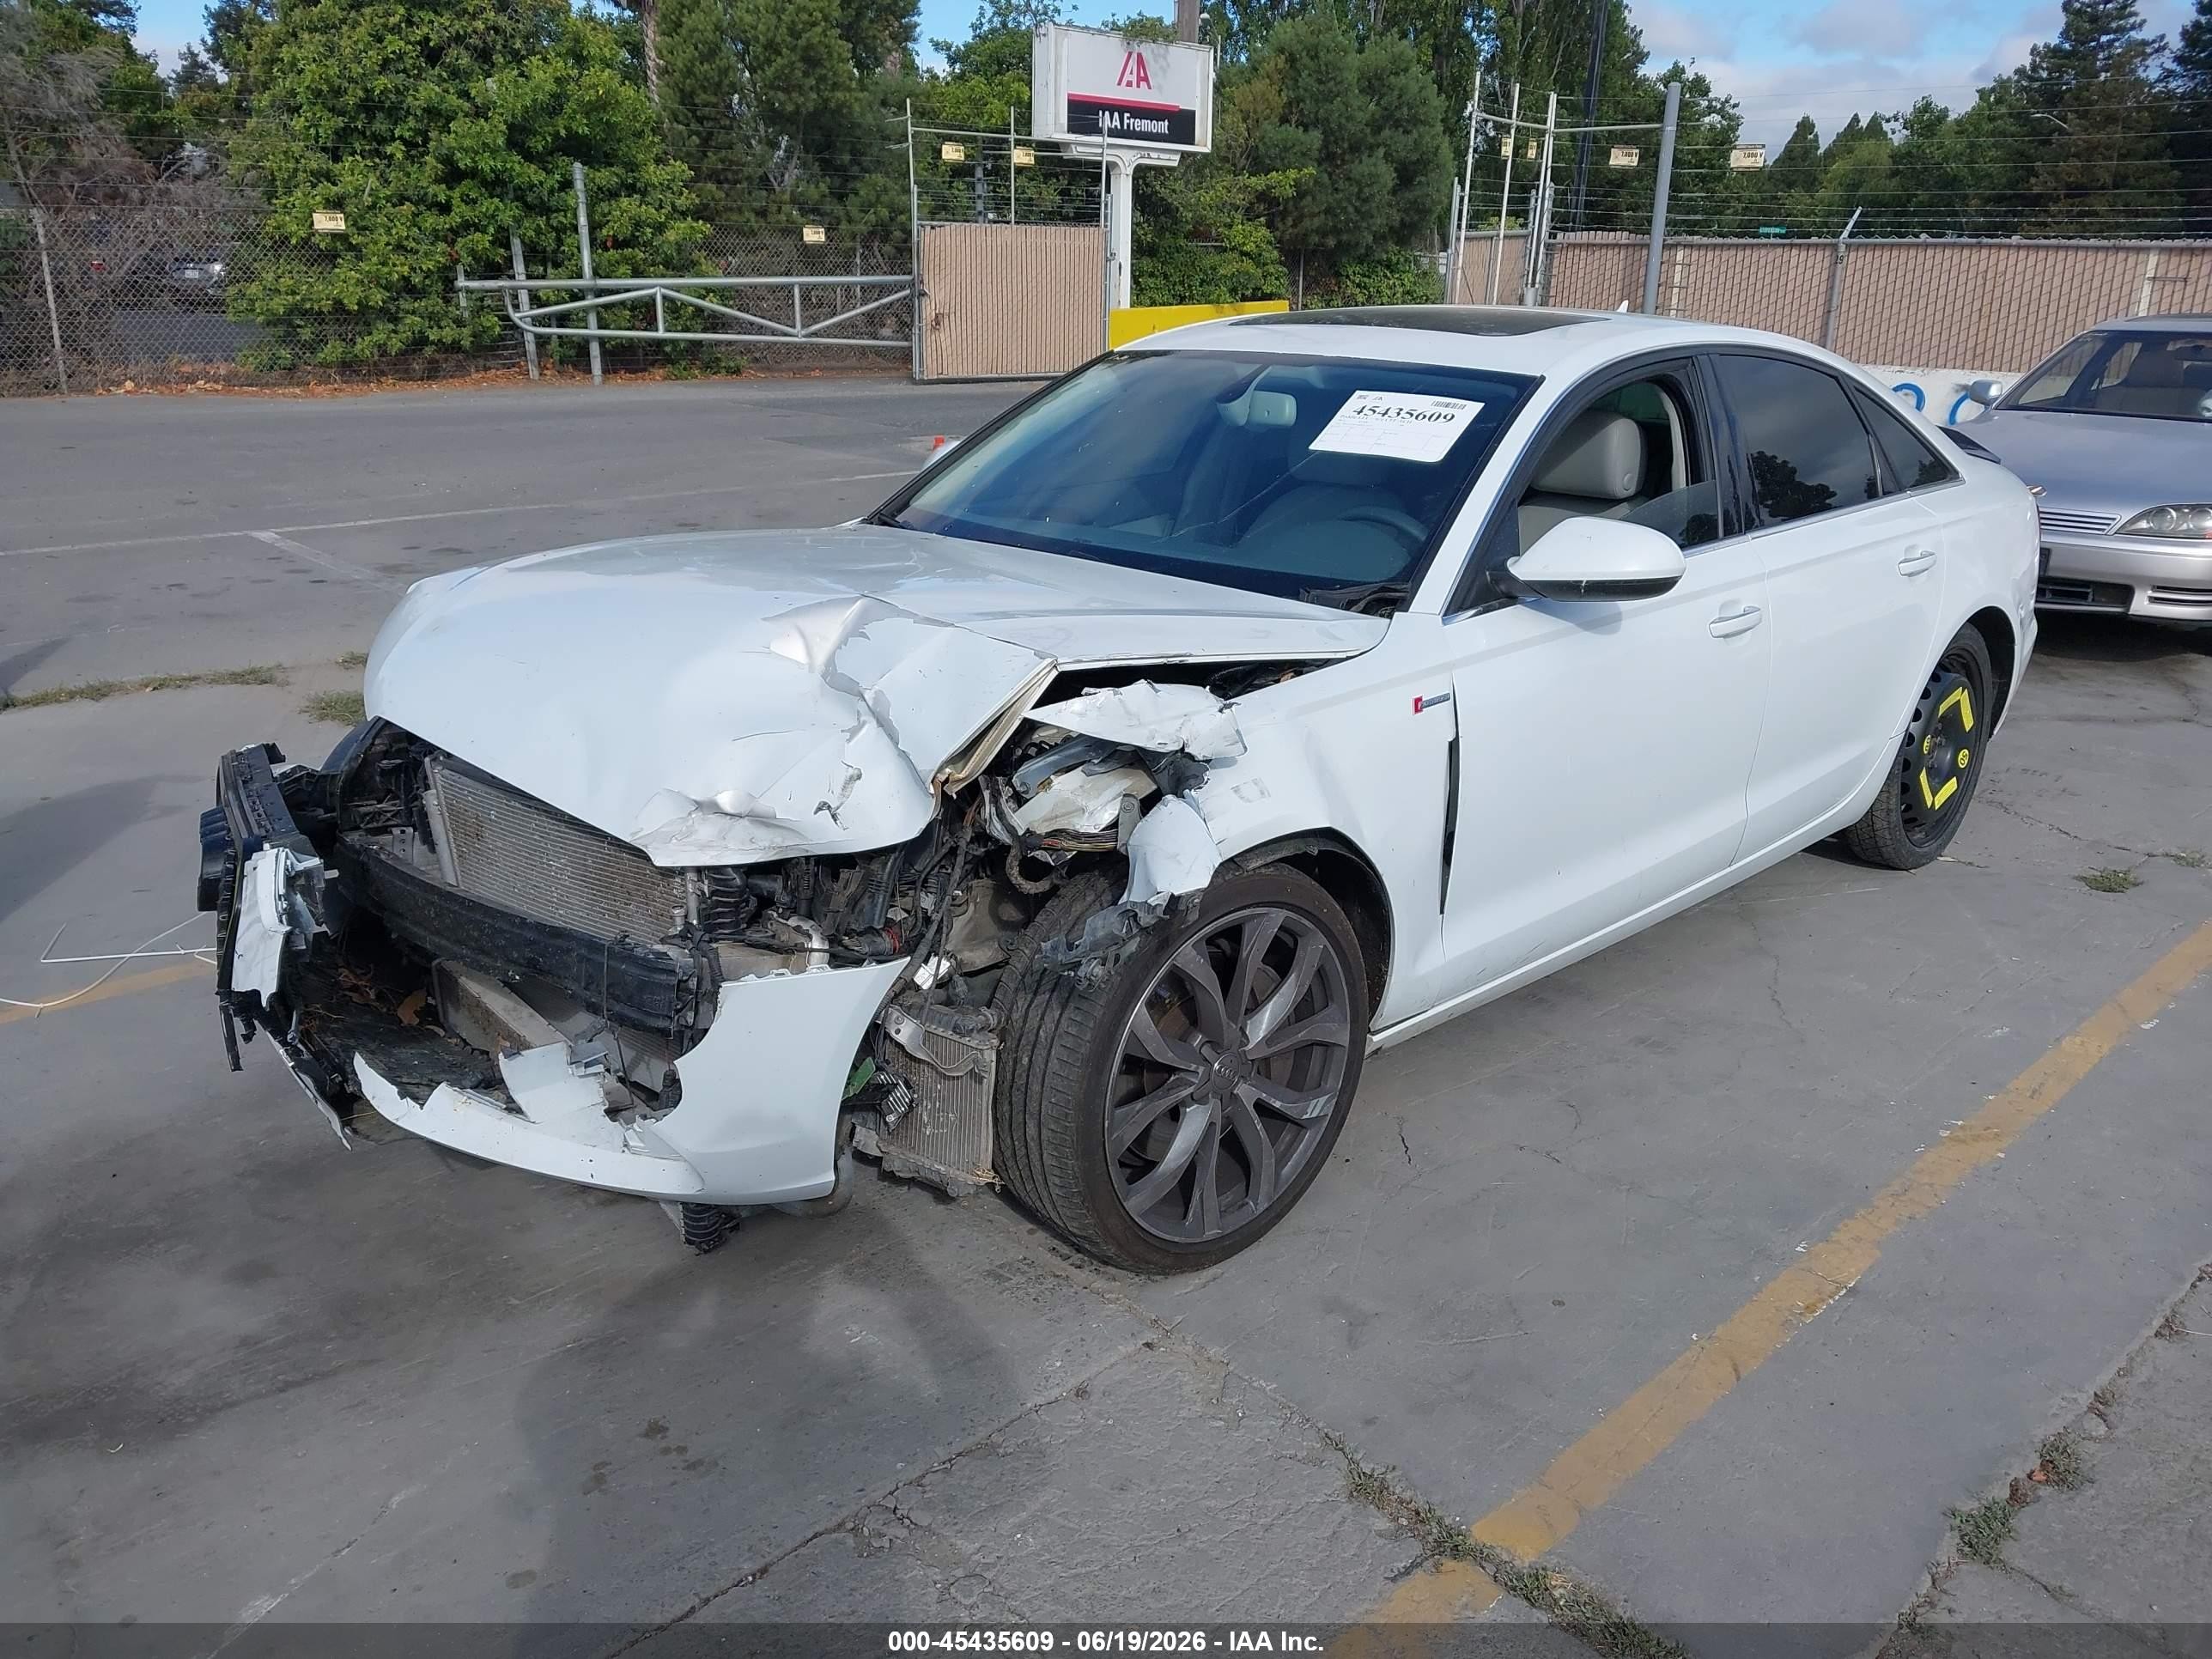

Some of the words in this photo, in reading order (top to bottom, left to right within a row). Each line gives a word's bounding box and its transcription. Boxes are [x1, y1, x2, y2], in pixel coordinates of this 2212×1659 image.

[1099, 110, 1121, 130] IAA
[1123, 112, 1170, 134] Fremont
[1352, 404, 1455, 424] 45435609
